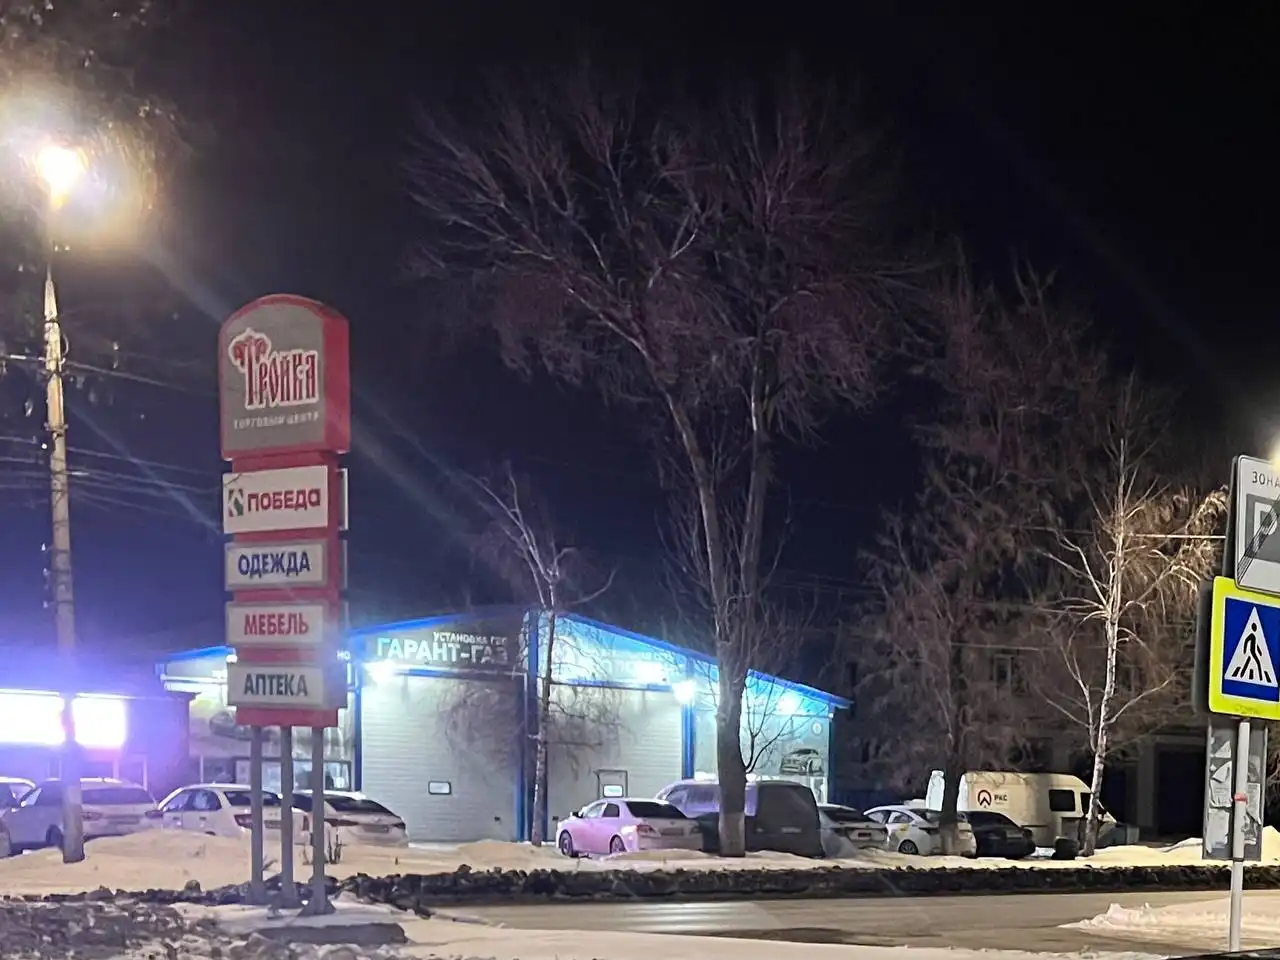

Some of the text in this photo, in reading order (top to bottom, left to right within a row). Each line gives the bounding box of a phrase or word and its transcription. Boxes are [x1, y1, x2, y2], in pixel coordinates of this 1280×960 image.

[1252, 471, 1280, 488] ЗОНА
[238, 551, 310, 578] ОДЕЖДА
[243, 612, 309, 636] МЕБЕЛЬ
[377, 637, 508, 664] ГАРАНТ-ГАЗ
[243, 673, 308, 697] АПТЕКА
